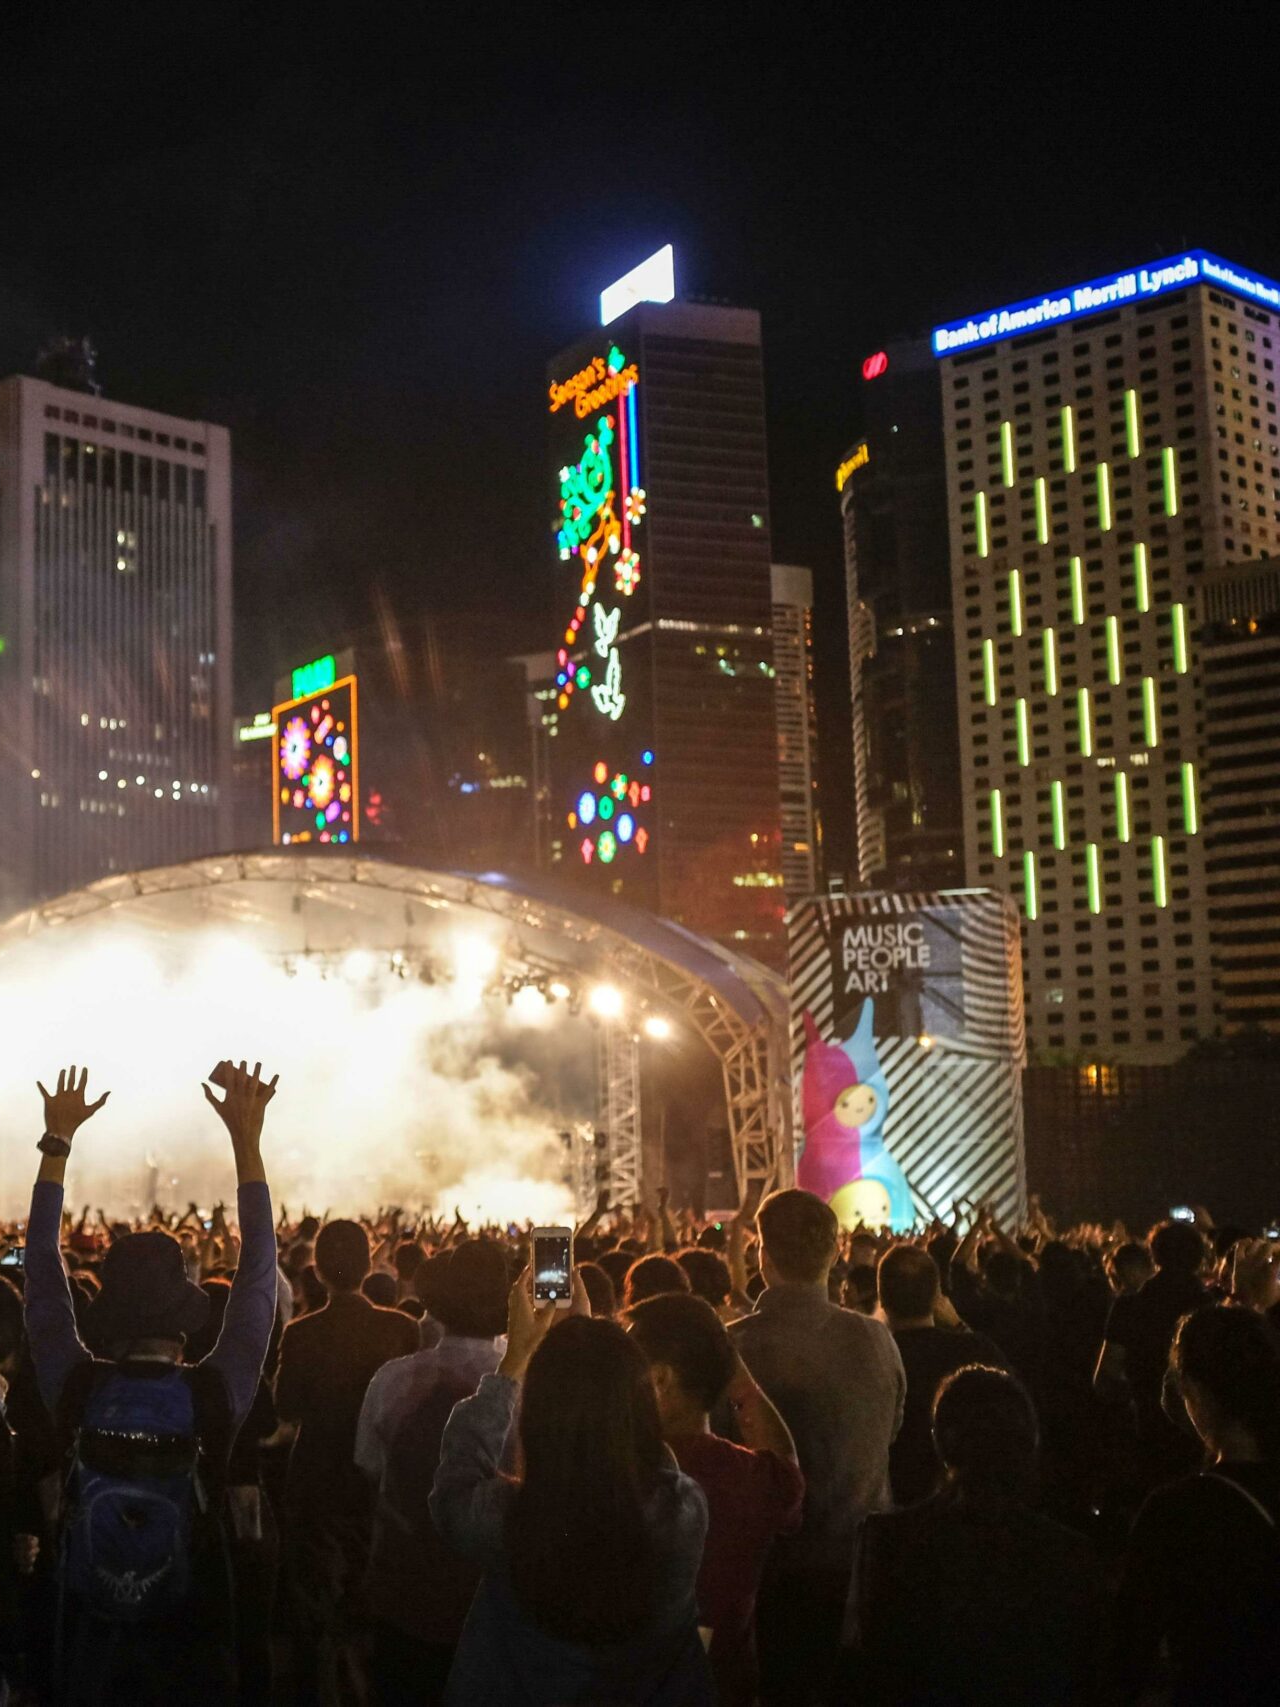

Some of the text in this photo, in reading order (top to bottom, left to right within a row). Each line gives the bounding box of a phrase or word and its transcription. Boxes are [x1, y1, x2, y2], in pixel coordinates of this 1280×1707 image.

[935, 257, 1199, 352] Bank of America Merrill Lynch
[843, 922, 925, 948] MUSIC
[843, 944, 932, 971] PEOPLE
[844, 970, 889, 994] ART
